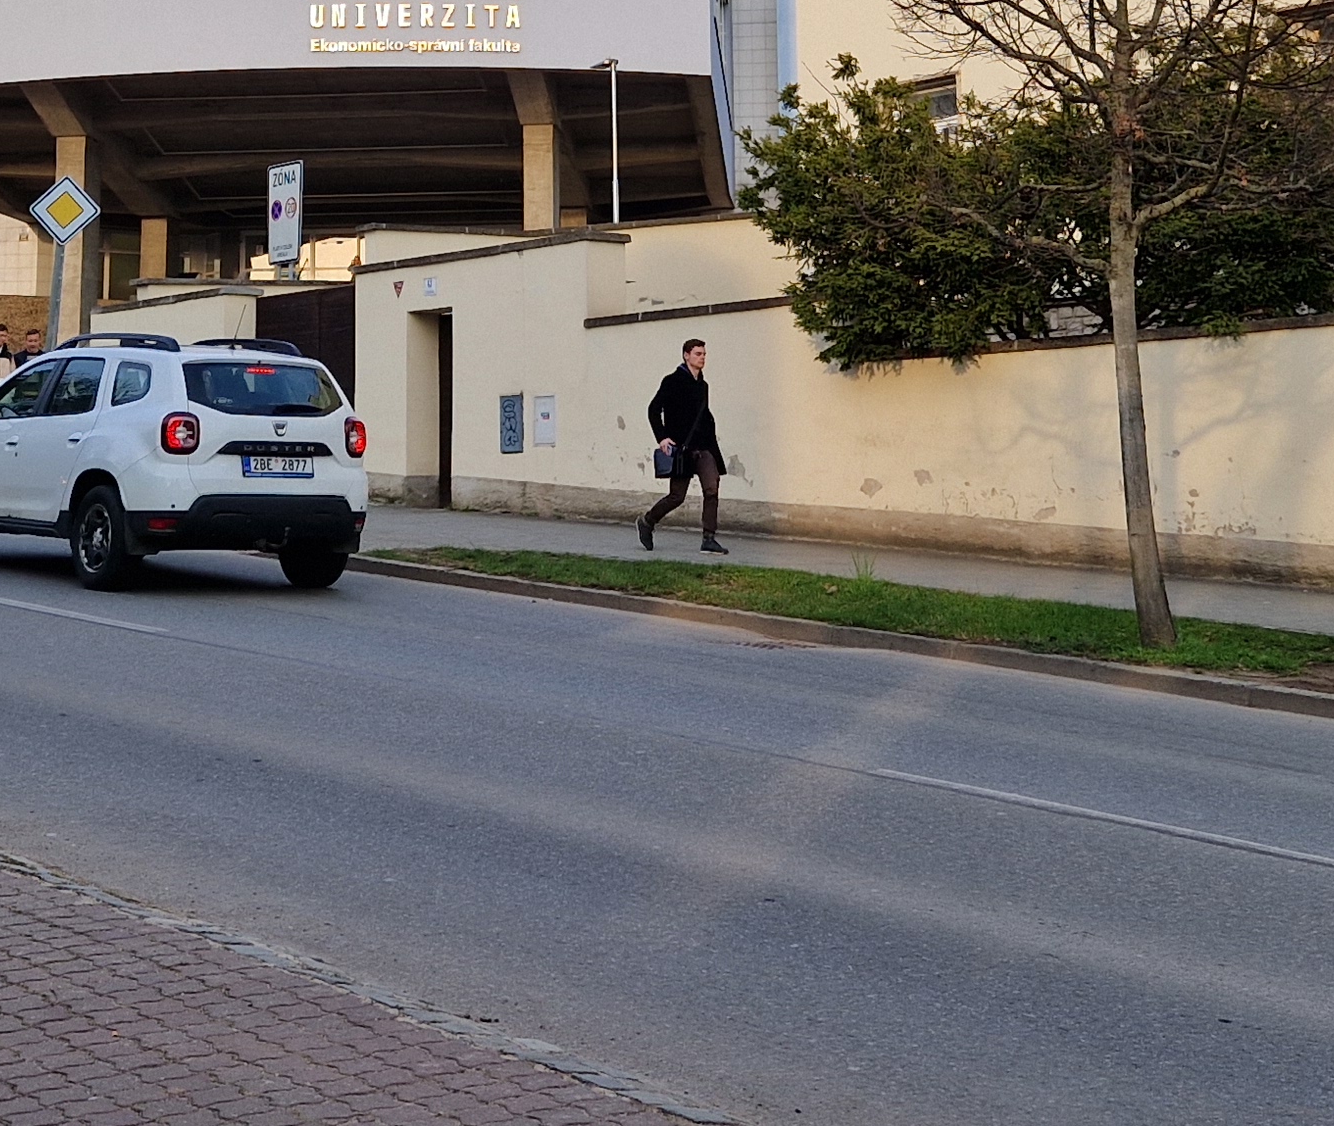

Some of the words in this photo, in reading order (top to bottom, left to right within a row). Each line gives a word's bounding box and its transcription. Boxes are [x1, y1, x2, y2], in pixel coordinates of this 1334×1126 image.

[309, 3, 520, 28] UNIVERZITA
[310, 38, 465, 54] Ekonomicko-správní
[468, 38, 521, 53] fakulta
[273, 169, 296, 187] ZÓNA
[253, 458, 273, 471] 2BE
[281, 458, 307, 471] 2877
